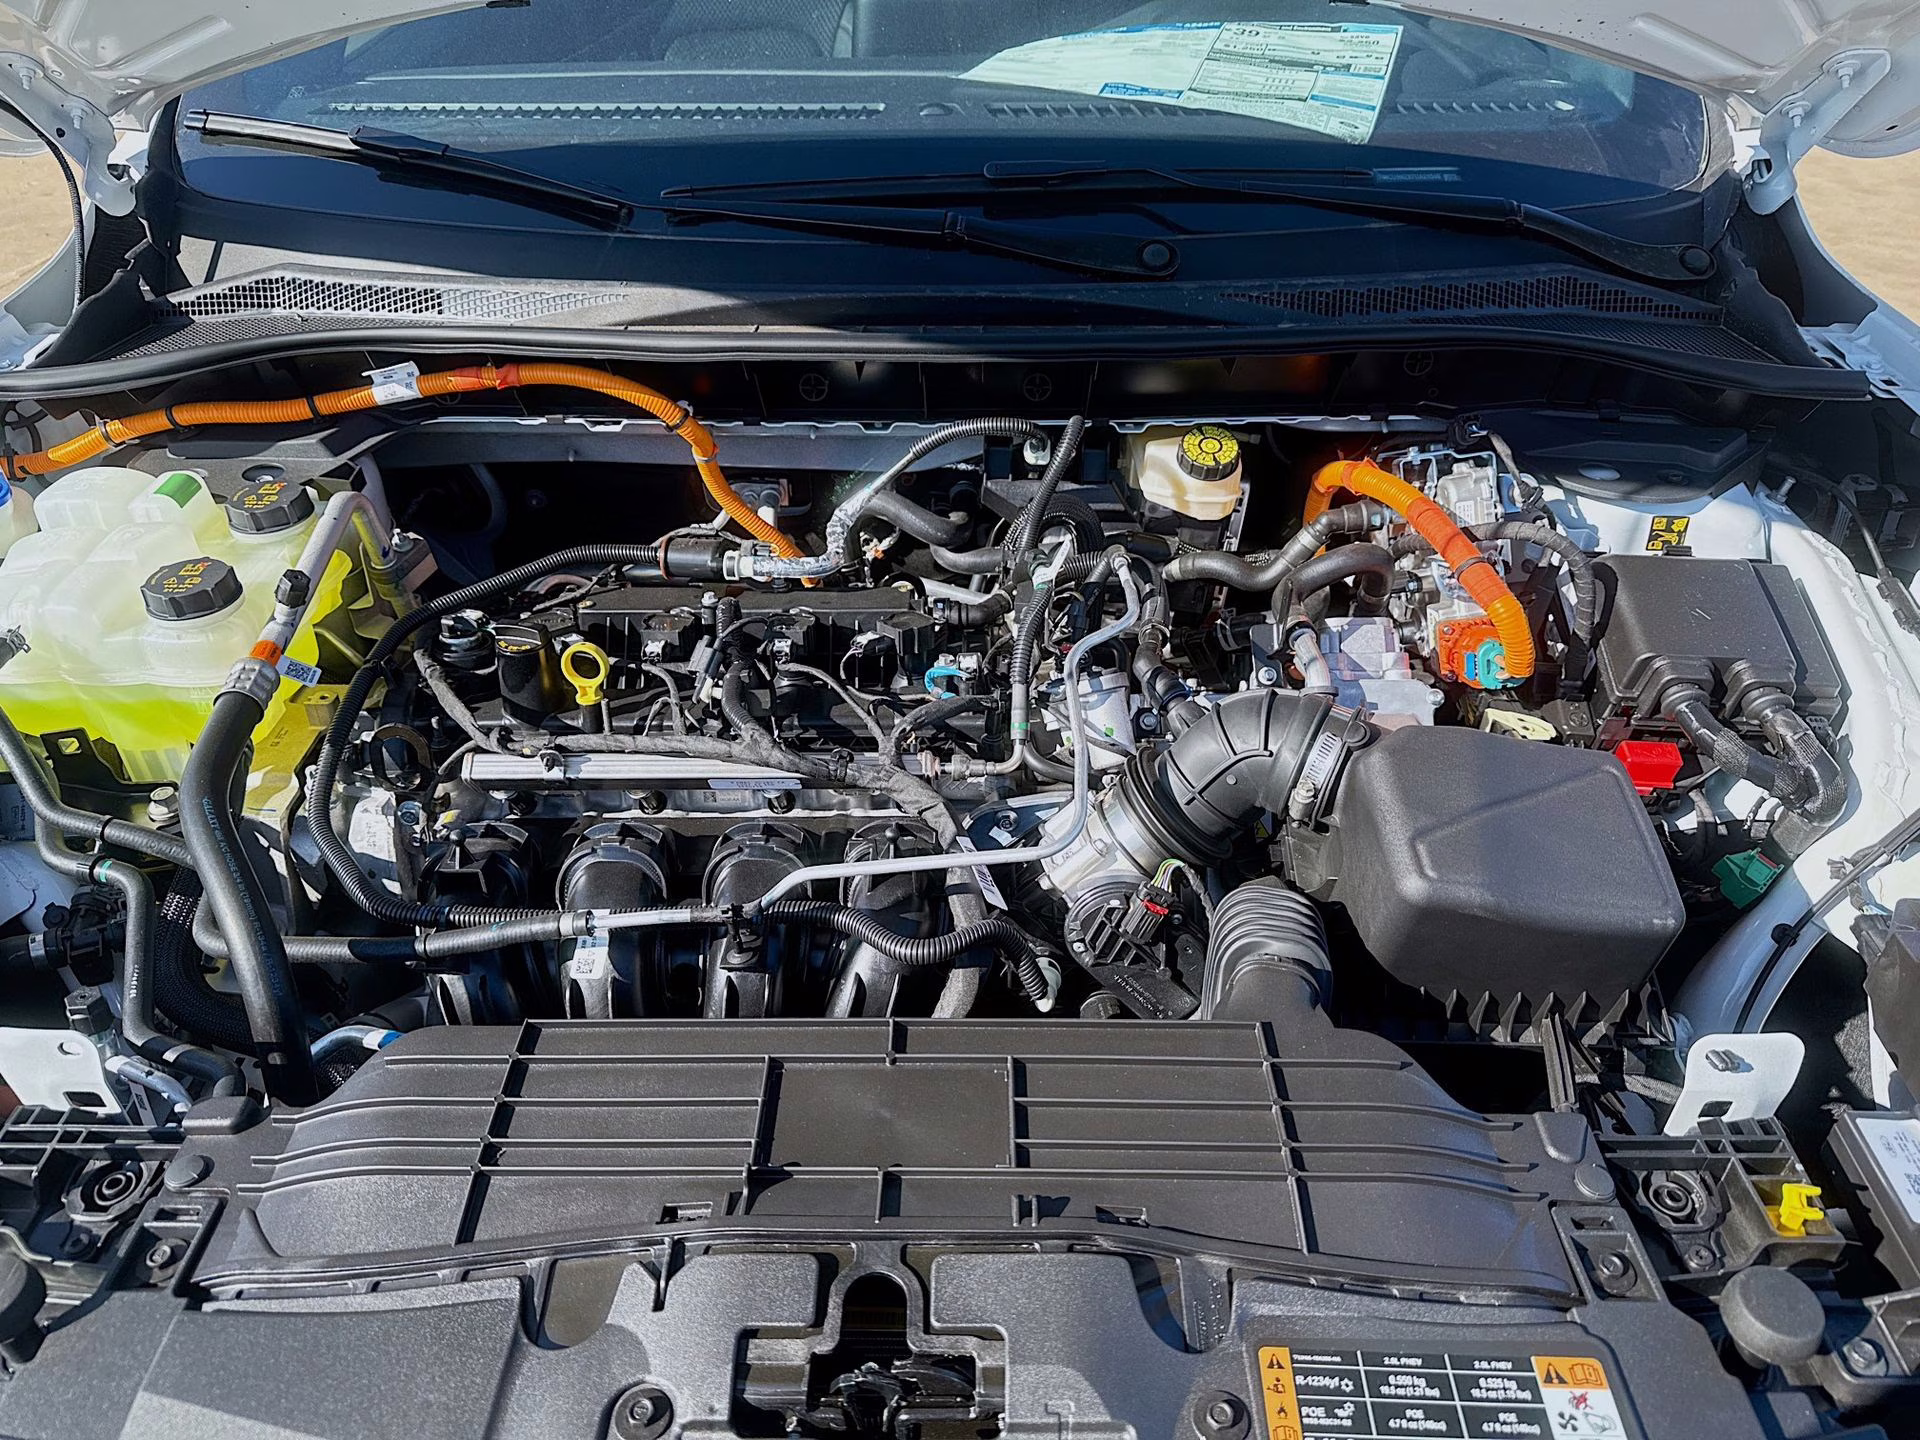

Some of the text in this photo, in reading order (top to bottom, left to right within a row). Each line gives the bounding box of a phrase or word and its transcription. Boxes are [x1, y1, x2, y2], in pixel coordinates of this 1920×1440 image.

[203, 797, 220, 829] GALAXY
[224, 851, 239, 872] HOSE
[1413, 1375, 1426, 1388] kg
[1504, 1378, 1517, 1390] kg
[1301, 1406, 1326, 1417] POE
[1405, 1408, 1425, 1419] POE
[1498, 1412, 1519, 1423] POE
